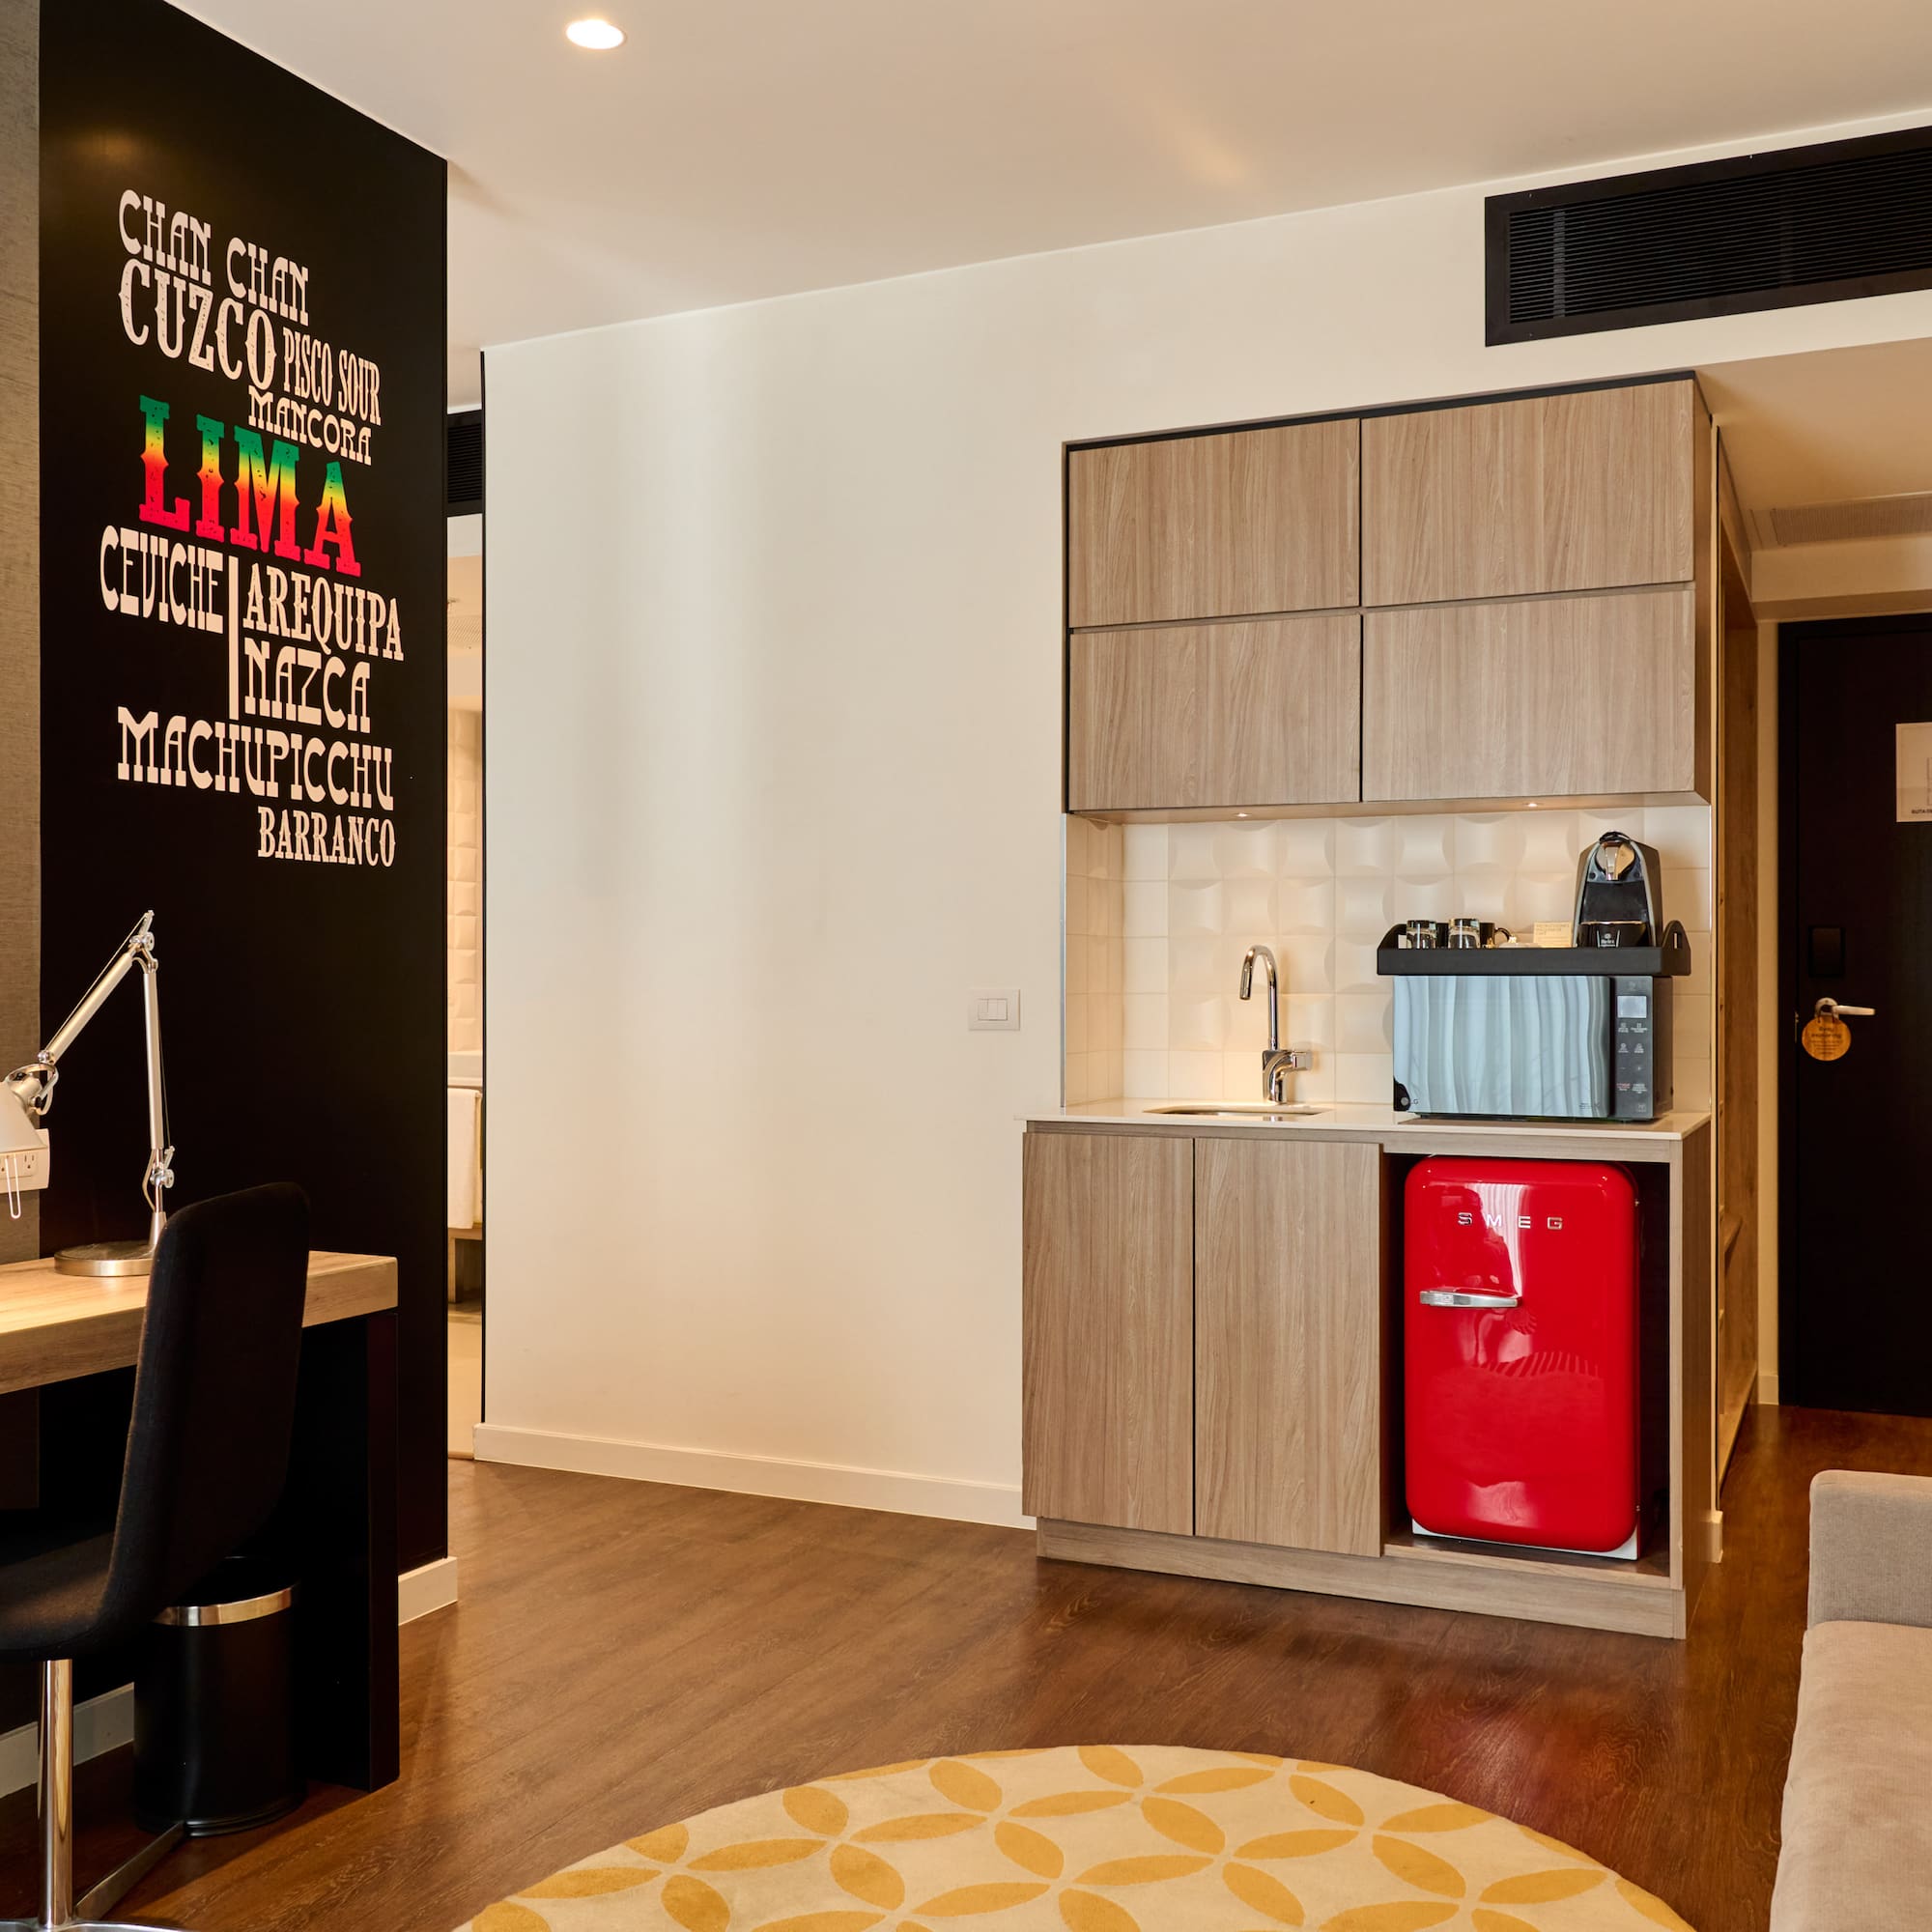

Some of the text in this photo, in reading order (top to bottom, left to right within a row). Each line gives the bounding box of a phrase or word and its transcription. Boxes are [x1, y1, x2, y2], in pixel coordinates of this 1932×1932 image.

[118, 189, 309, 327] CHAN CHAN
[118, 258, 277, 390] CUZCO
[248, 385, 372, 466] MANCORA
[283, 327, 382, 426] PISCO SOUR
[138, 394, 362, 578] LIMA
[99, 526, 224, 634] CEVICHE
[242, 563, 405, 662] AREQUIPA
[244, 638, 371, 733] NAZCA
[118, 706, 394, 811] MACHUPICCHU
[257, 806, 396, 867] BARRANCO
[1458, 1211, 1563, 1230] SMEG
